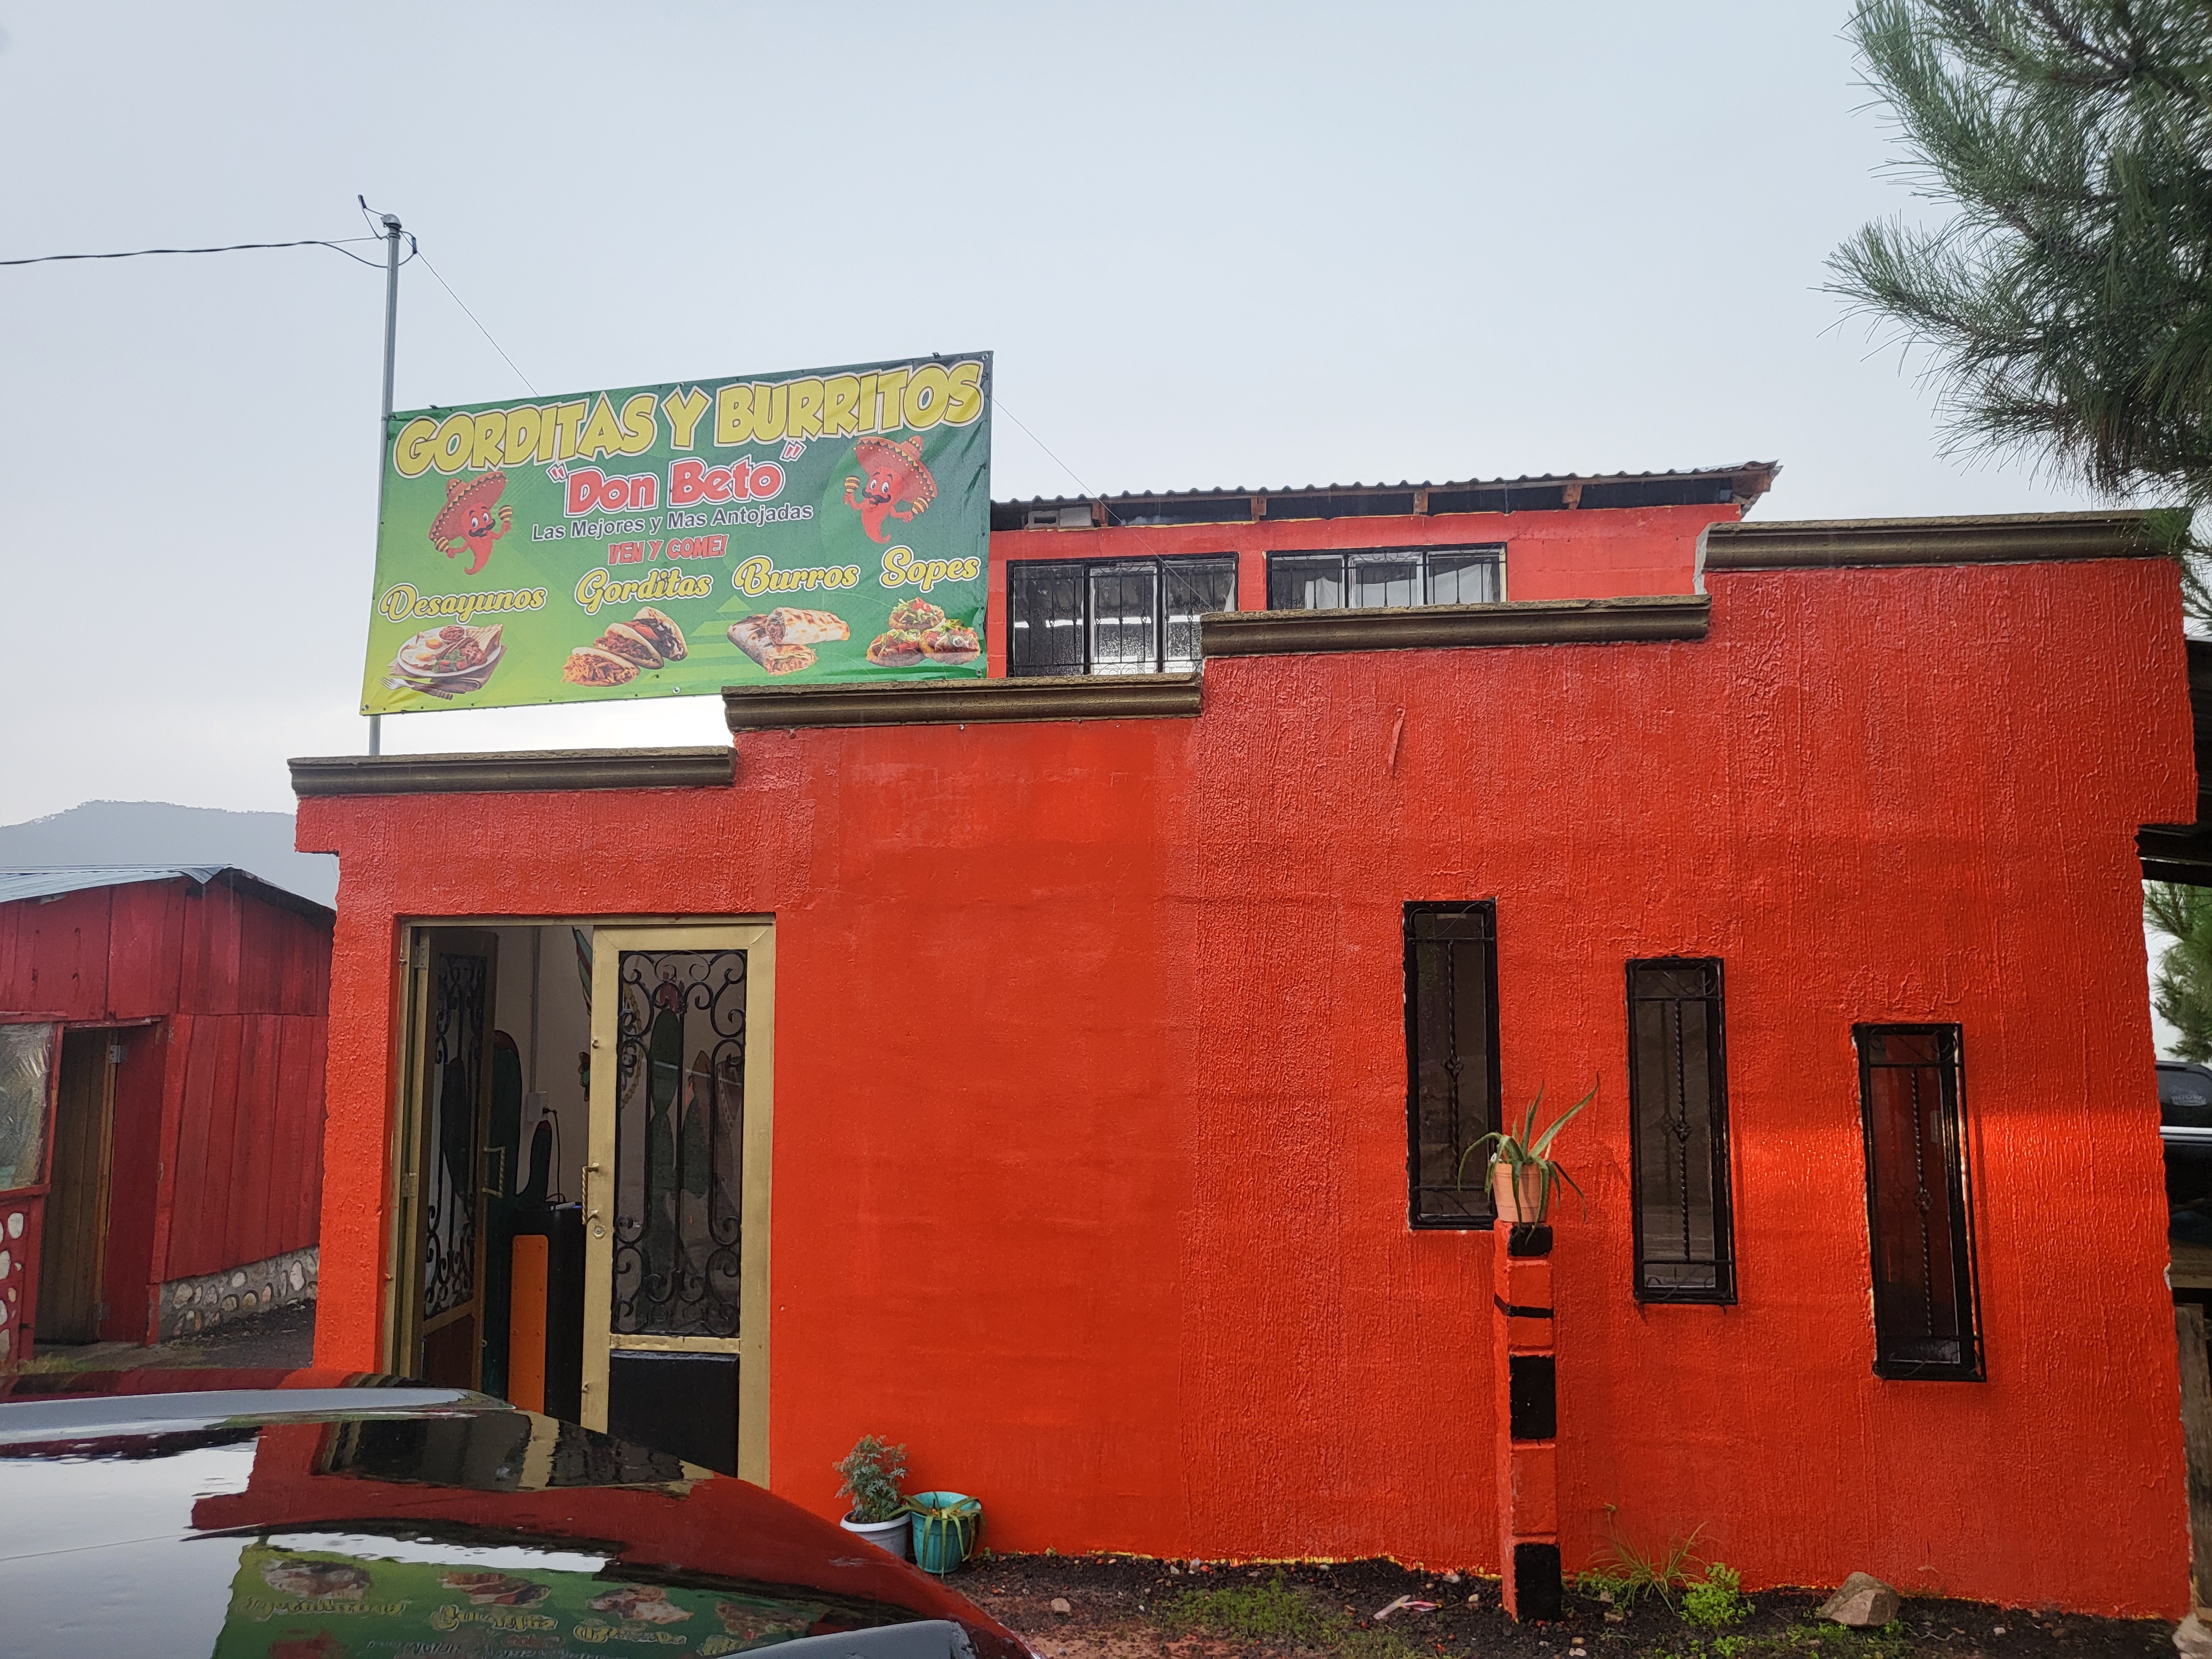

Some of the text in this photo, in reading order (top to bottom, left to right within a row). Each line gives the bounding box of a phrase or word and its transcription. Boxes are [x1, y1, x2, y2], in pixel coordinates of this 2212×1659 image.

[394, 362, 983, 476] GORDITAS Y BURRITOS
[532, 503, 813, 541] Las Mejores y Mas Antojadas
[608, 534, 728, 565] VEN Y COME!
[880, 546, 980, 592] Sopes
[576, 568, 712, 613] Gorditas
[733, 555, 859, 596] Burros
[379, 583, 545, 622] Desayunos
